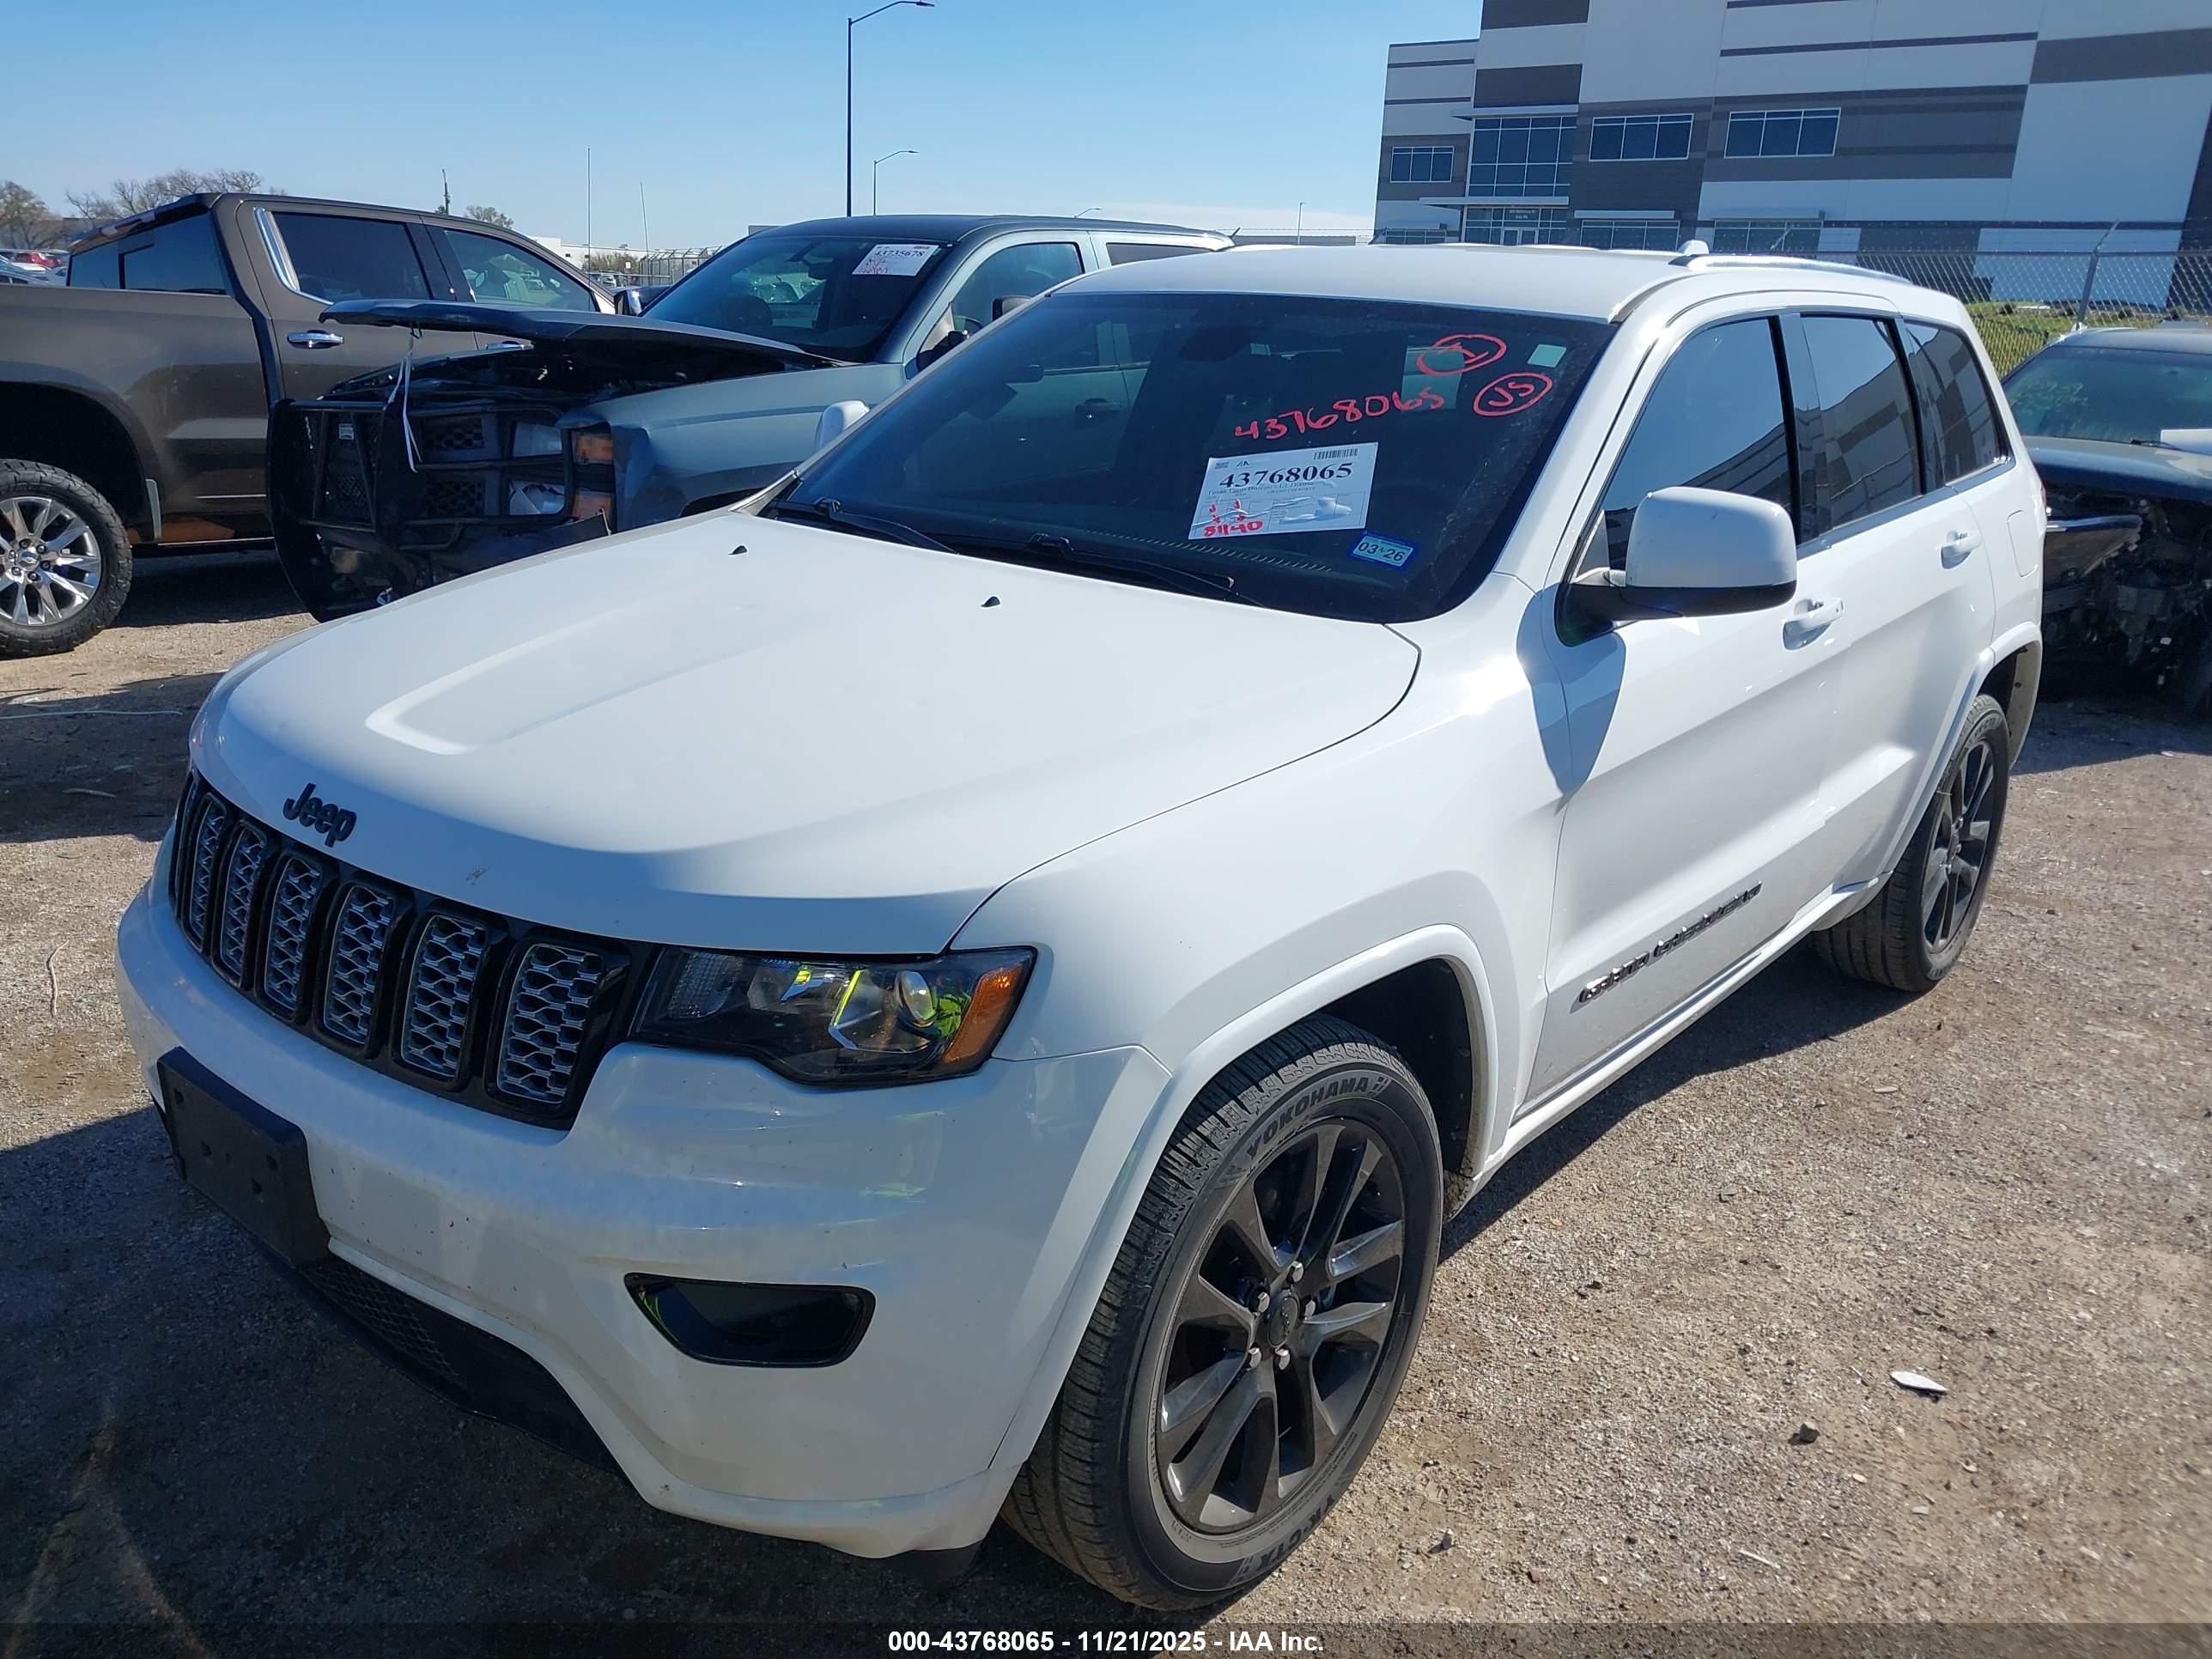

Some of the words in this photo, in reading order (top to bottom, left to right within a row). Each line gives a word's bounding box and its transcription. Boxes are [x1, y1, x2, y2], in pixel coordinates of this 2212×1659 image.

[1235, 386, 1444, 440] 43768065
[1219, 462, 1353, 489] 43768065
[283, 782, 357, 848] Jeep
[1246, 1077, 1370, 1160] YOKOHAMA
